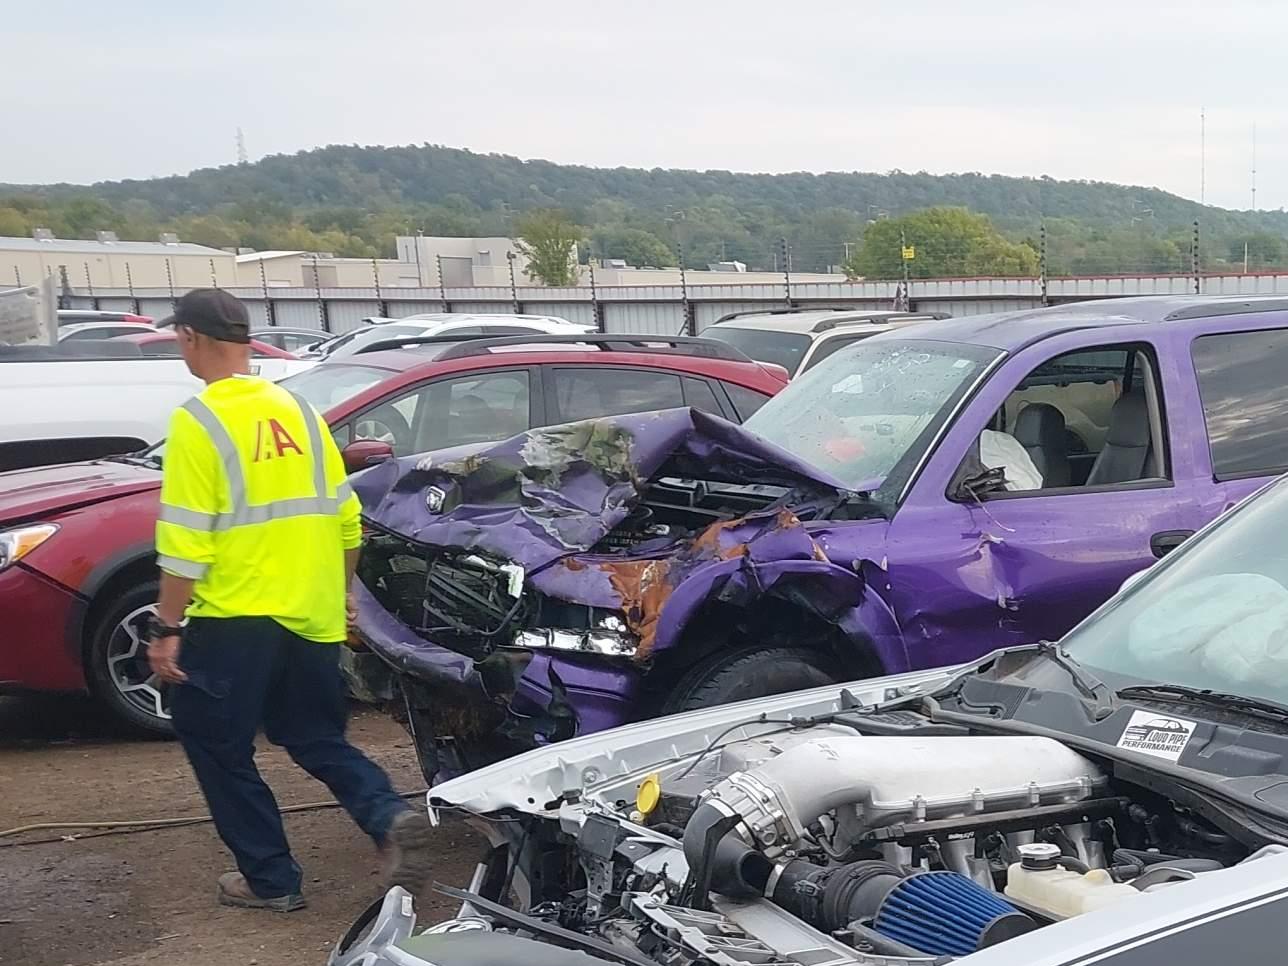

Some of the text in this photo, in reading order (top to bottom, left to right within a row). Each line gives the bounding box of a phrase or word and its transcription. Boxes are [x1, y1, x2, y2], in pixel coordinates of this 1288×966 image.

[1147, 731, 1188, 746] LOUD PIPE
[1121, 740, 1183, 753] PERFORMANCE
